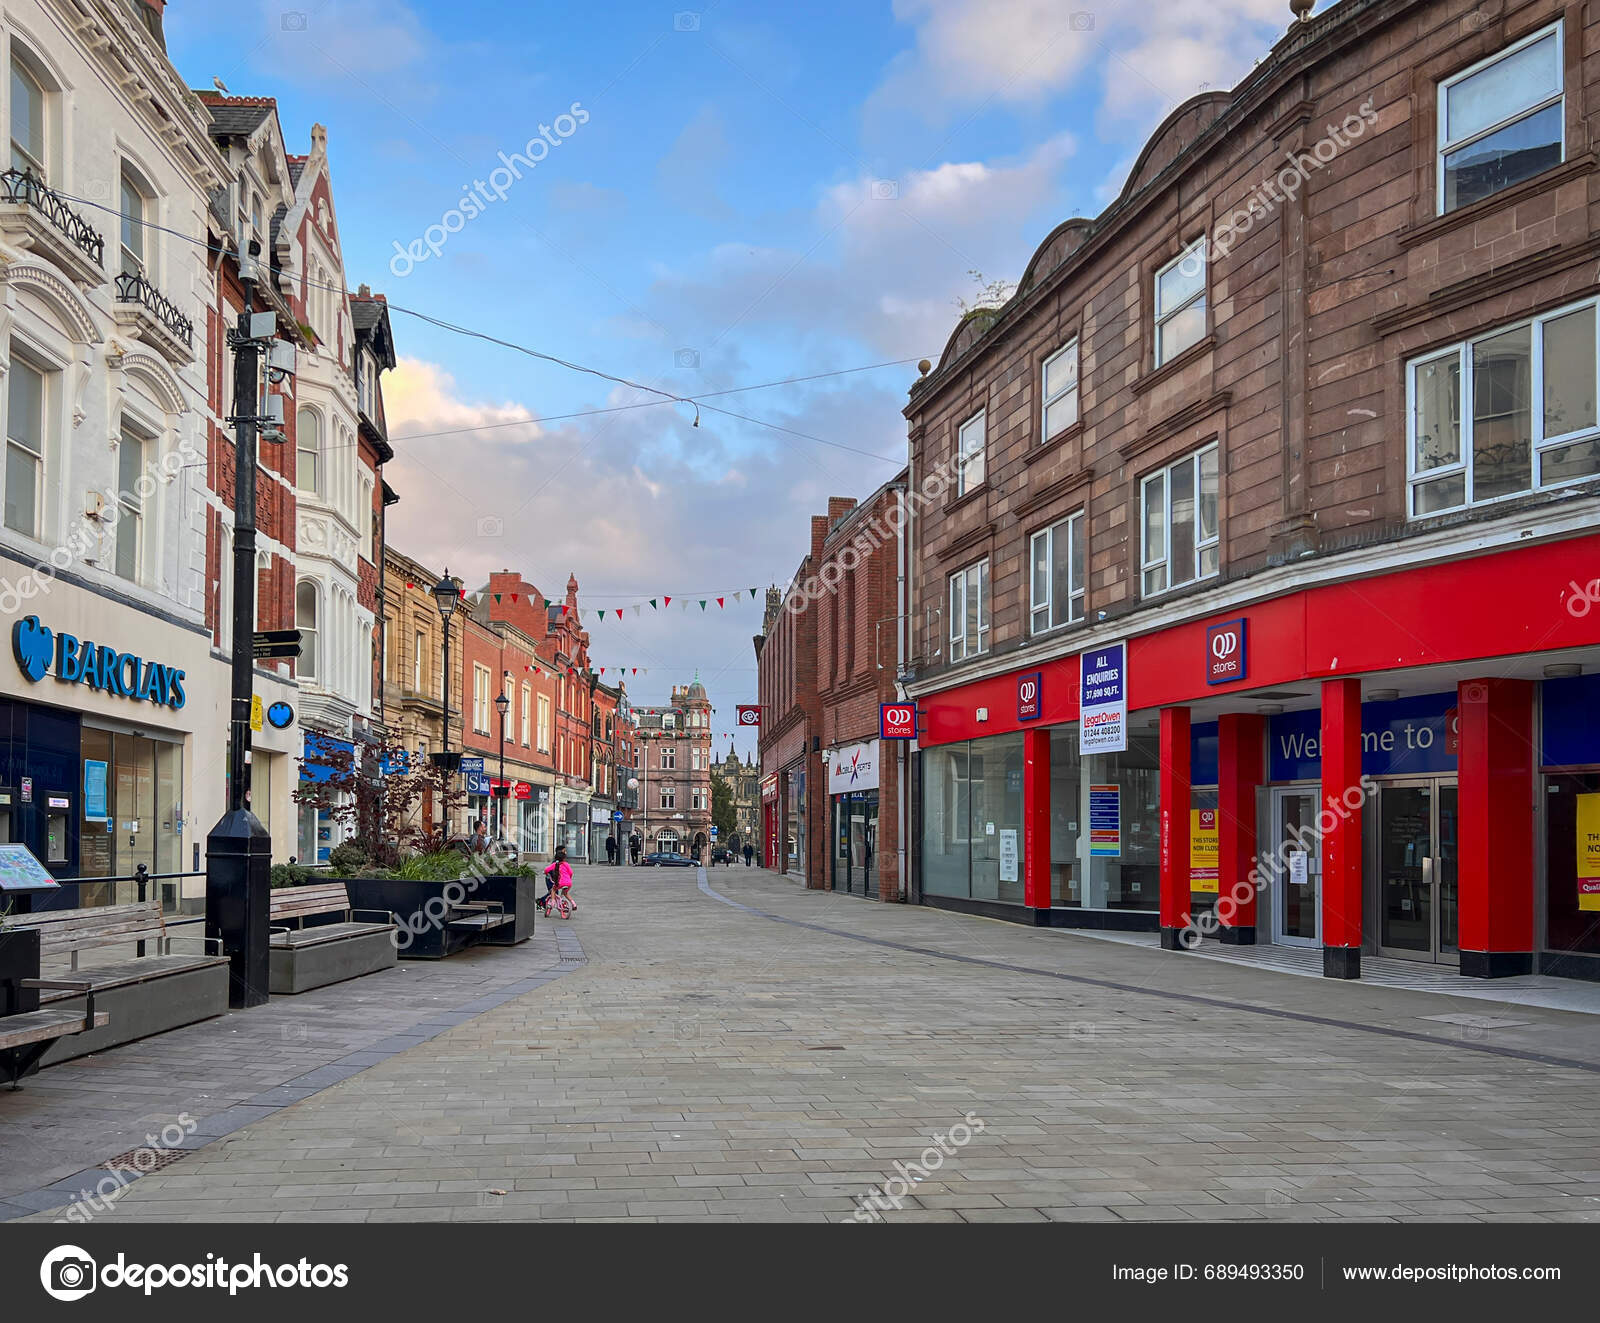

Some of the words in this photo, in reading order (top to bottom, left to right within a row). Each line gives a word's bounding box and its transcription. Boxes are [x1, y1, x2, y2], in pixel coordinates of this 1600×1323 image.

[1213, 631, 1237, 660] QD
[1096, 655, 1108, 668] ALL
[1213, 660, 1237, 674] stores
[57, 632, 186, 709] BARCLAYS
[1086, 669, 1118, 685] ENQUIRIES
[1020, 681, 1035, 702] QD
[1020, 703, 1035, 714] stores
[886, 709, 911, 726] QD
[887, 726, 911, 734] stores
[1084, 728, 1100, 737] 01244
[1101, 725, 1120, 735] 408200
[1404, 724, 1434, 749] to
[1201, 812, 1214, 822] QD
